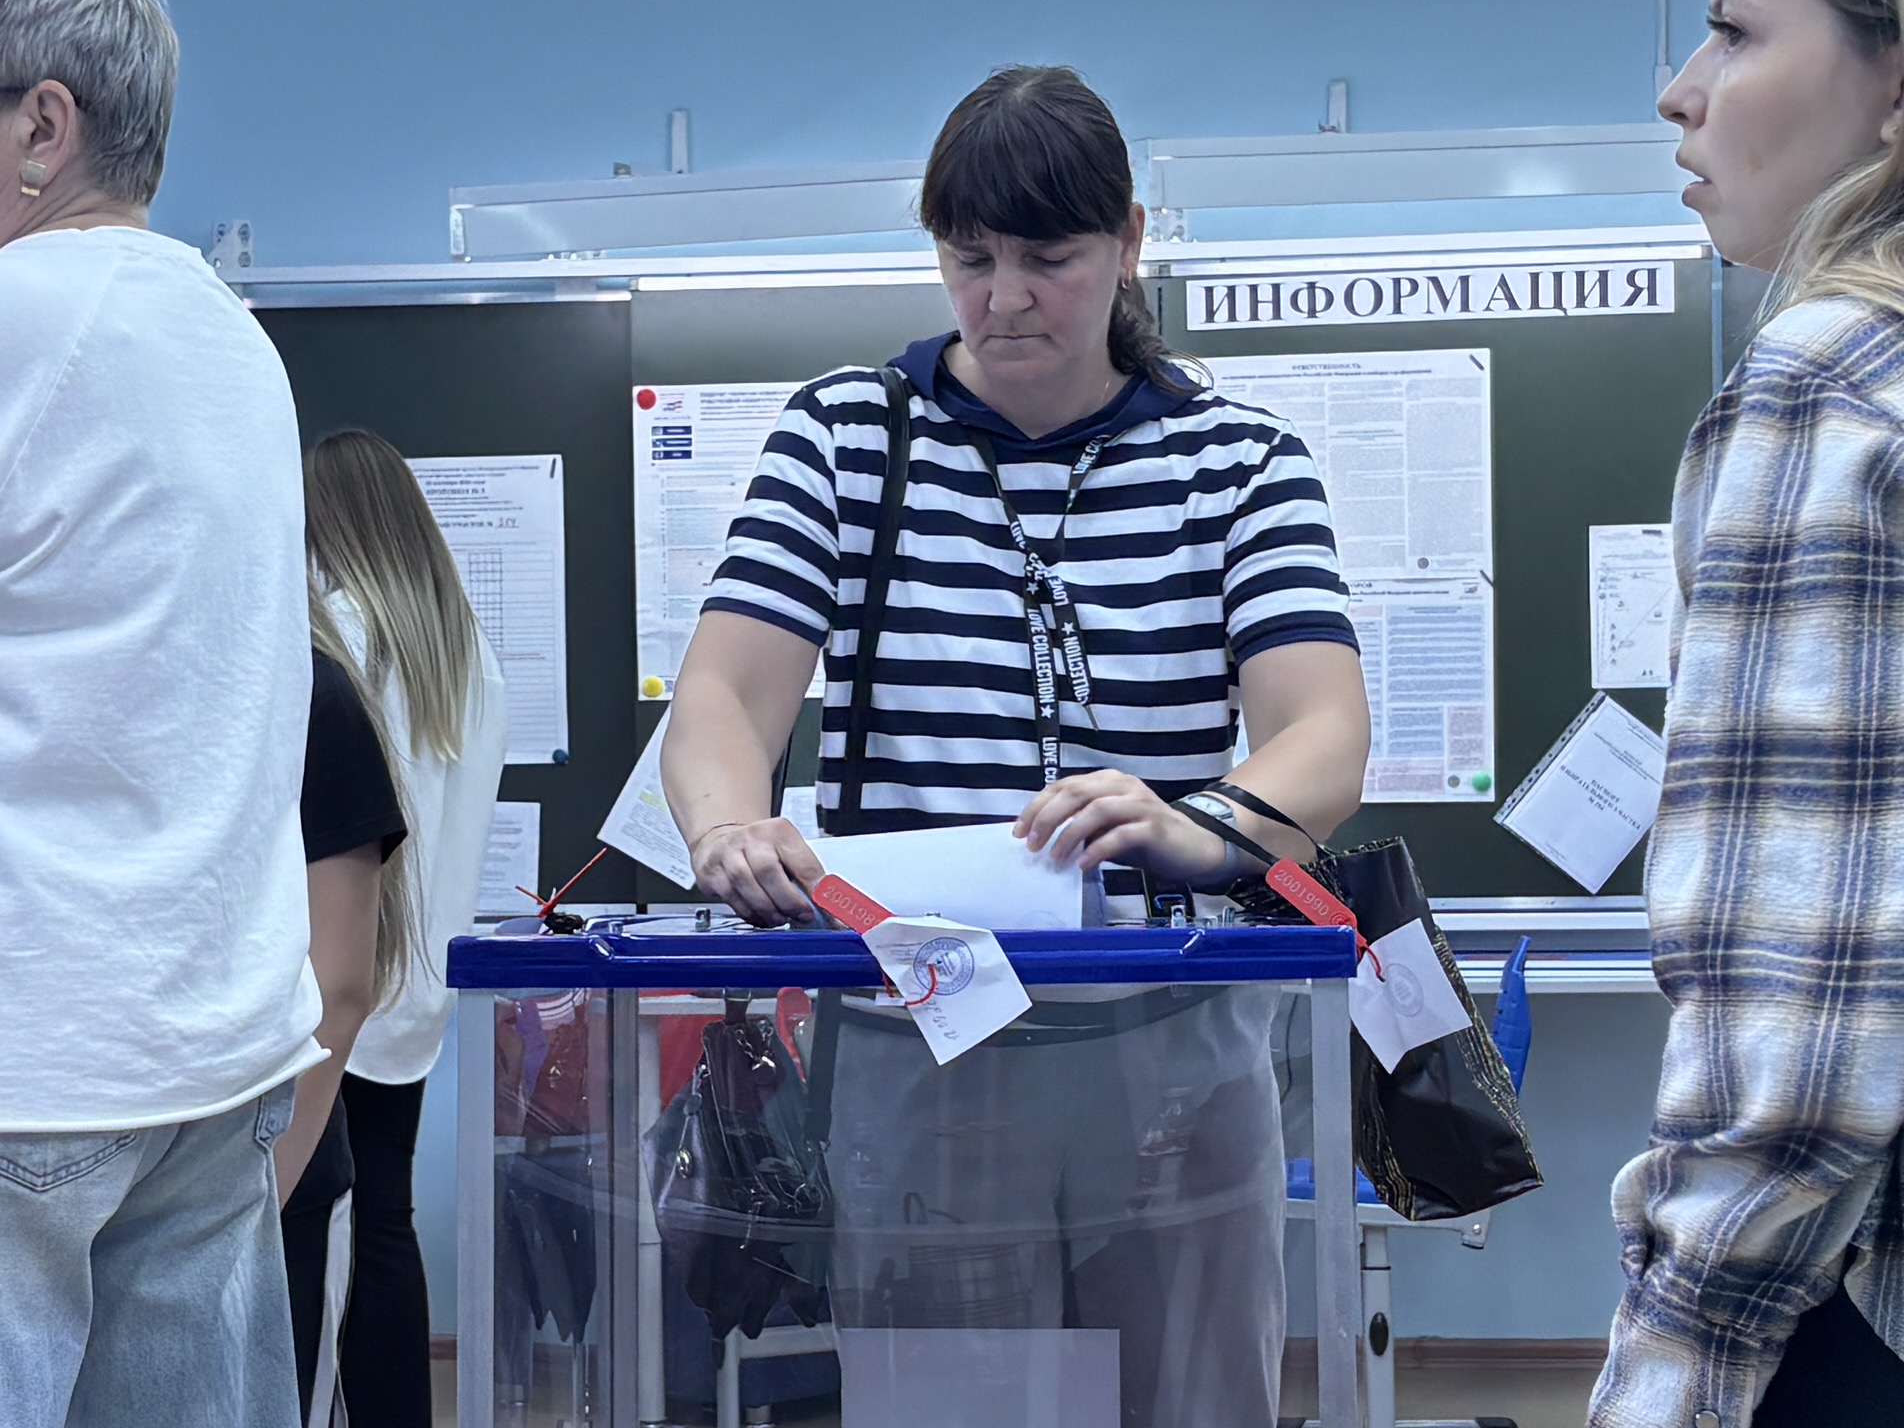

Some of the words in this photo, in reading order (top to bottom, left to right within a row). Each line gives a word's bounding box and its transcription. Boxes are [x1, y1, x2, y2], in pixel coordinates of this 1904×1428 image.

[1202, 266, 1661, 325] ИНФОРМАЦИЯ
[1048, 575, 1070, 607] LOVE
[1026, 608, 1047, 635] LOVE
[1032, 634, 1056, 704] COLLECTION
[1041, 736, 1058, 766] LOVE
